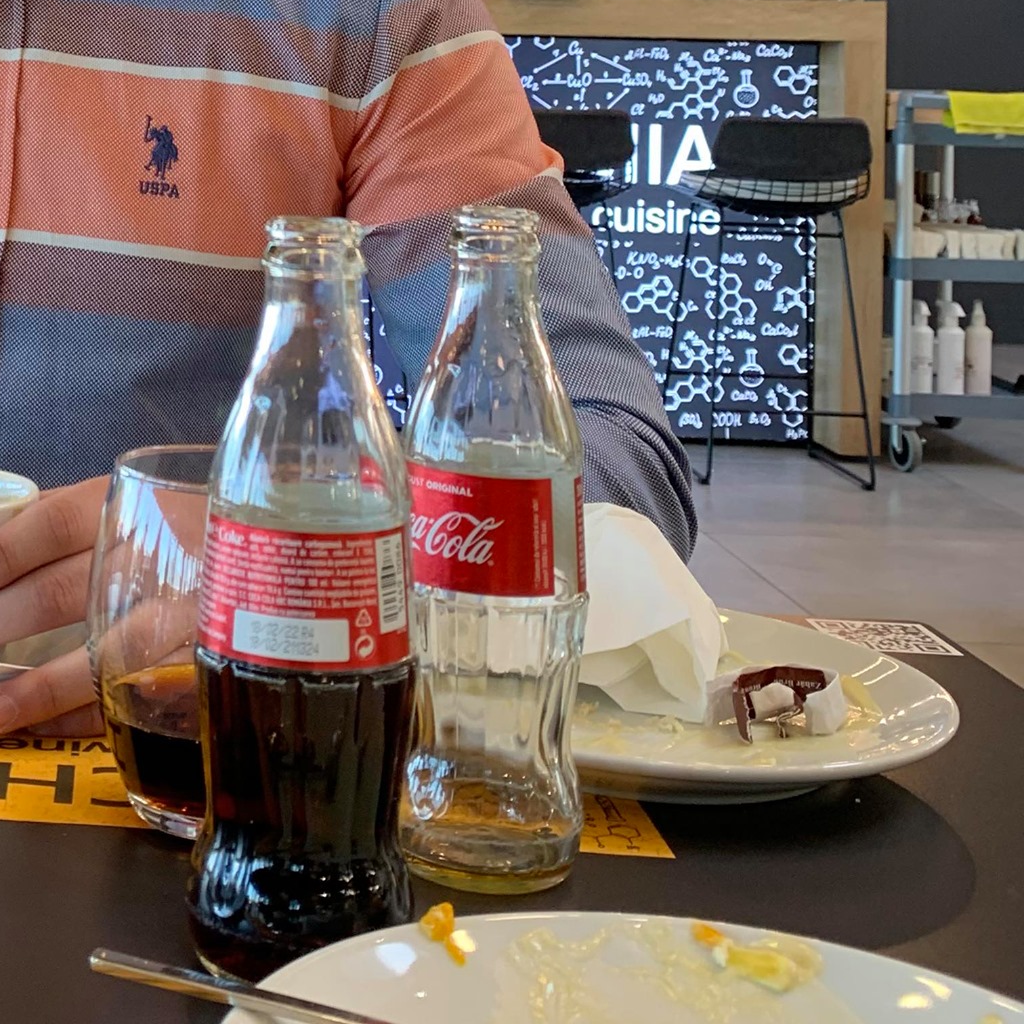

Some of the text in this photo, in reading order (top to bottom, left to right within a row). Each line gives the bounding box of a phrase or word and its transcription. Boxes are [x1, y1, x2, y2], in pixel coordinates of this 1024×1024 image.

[139, 180, 179, 198] USPA
[591, 199, 722, 235] cuisine
[426, 478, 474, 497] ORIGINAL
